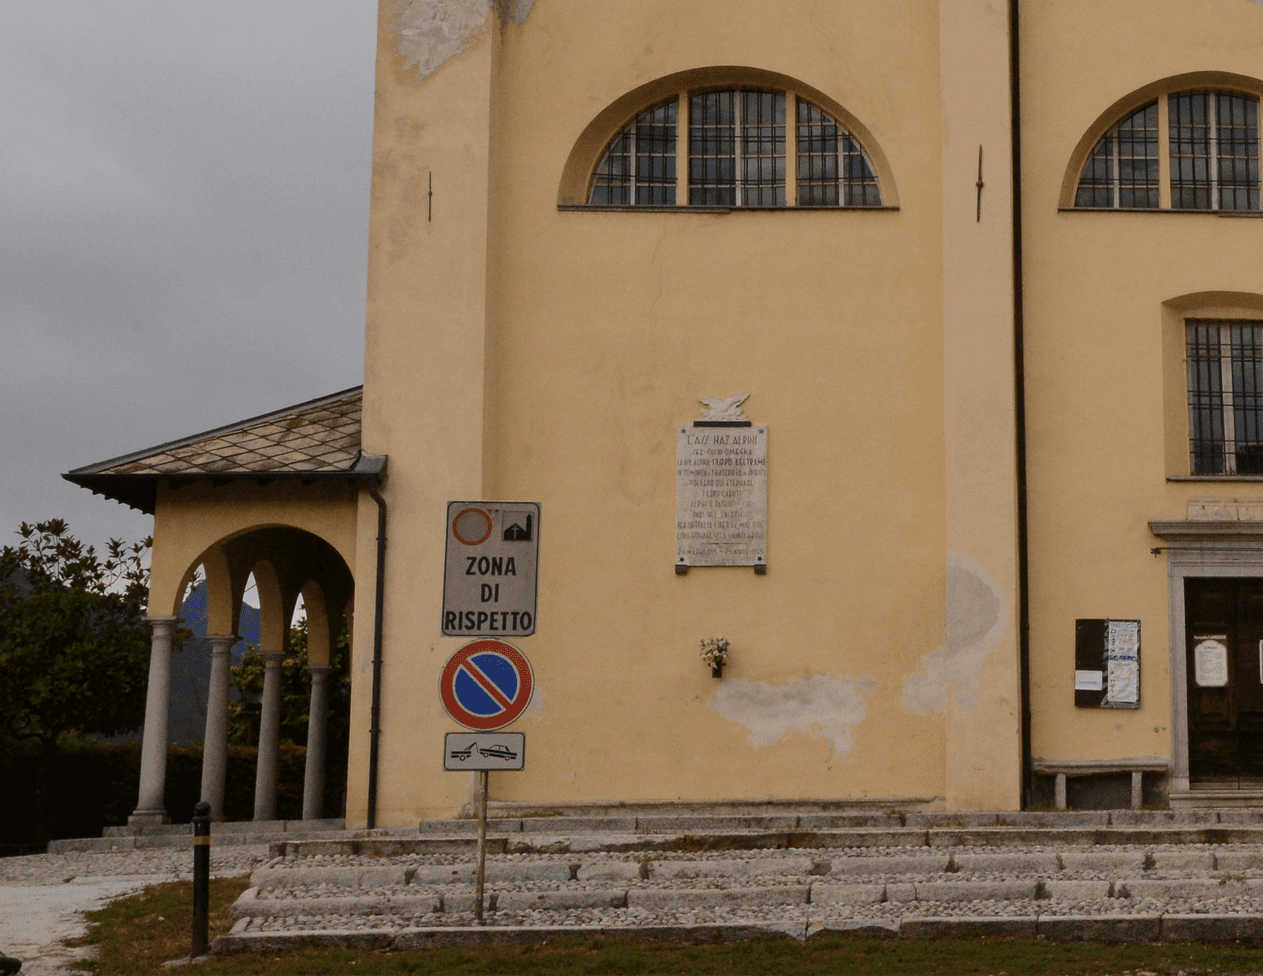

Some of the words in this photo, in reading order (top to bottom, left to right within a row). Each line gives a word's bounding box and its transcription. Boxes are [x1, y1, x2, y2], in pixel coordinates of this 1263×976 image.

[732, 434, 758, 445] ALPINI
[465, 556, 516, 576] ZONA
[481, 583, 499, 602] DI
[445, 611, 532, 631] RISPETTO
